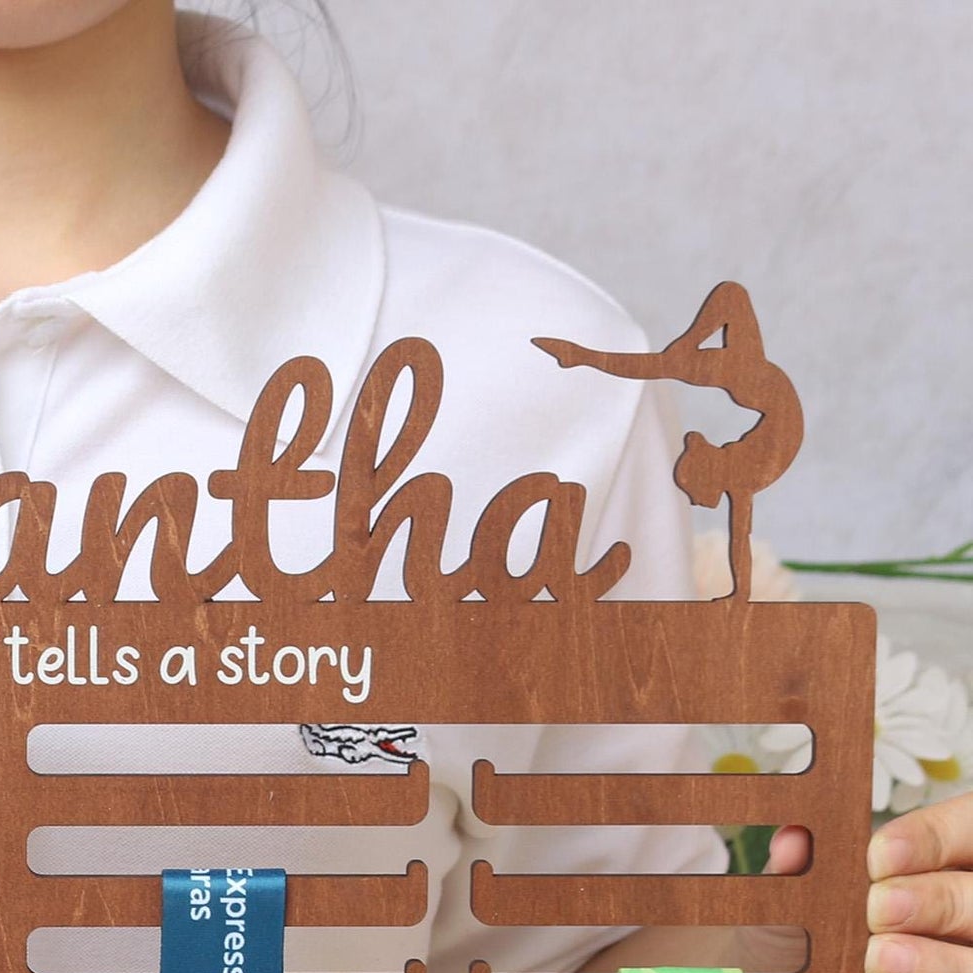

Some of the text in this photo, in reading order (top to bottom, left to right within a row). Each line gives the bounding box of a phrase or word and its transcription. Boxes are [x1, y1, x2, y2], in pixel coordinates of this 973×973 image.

[3, 624, 141, 686] tells
[160, 645, 198, 686] a
[216, 625, 372, 704] story
